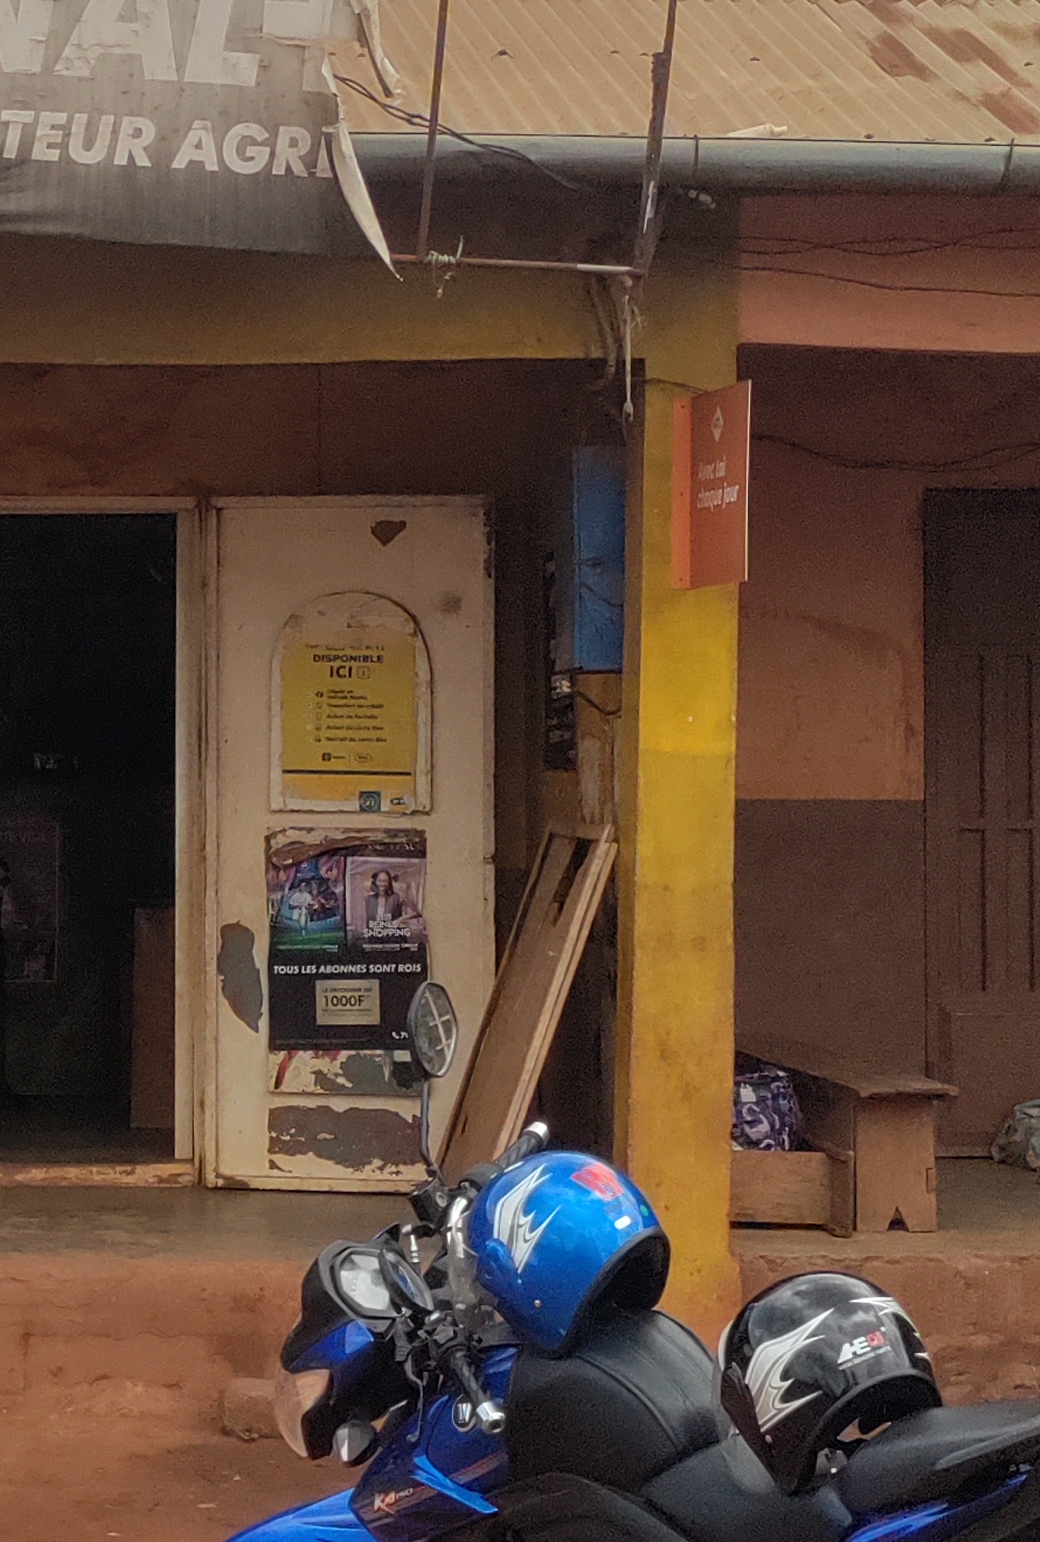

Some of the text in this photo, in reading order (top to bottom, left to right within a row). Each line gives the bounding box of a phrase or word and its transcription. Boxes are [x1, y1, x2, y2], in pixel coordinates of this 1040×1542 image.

[313, 653, 384, 664] DISPONIBLE
[329, 665, 353, 679] ICI
[273, 965, 299, 974] TOUS
[301, 964, 317, 974] LES
[369, 964, 395, 973] SONT
[397, 963, 421, 973] ROIS
[323, 994, 365, 1008] 1000F
